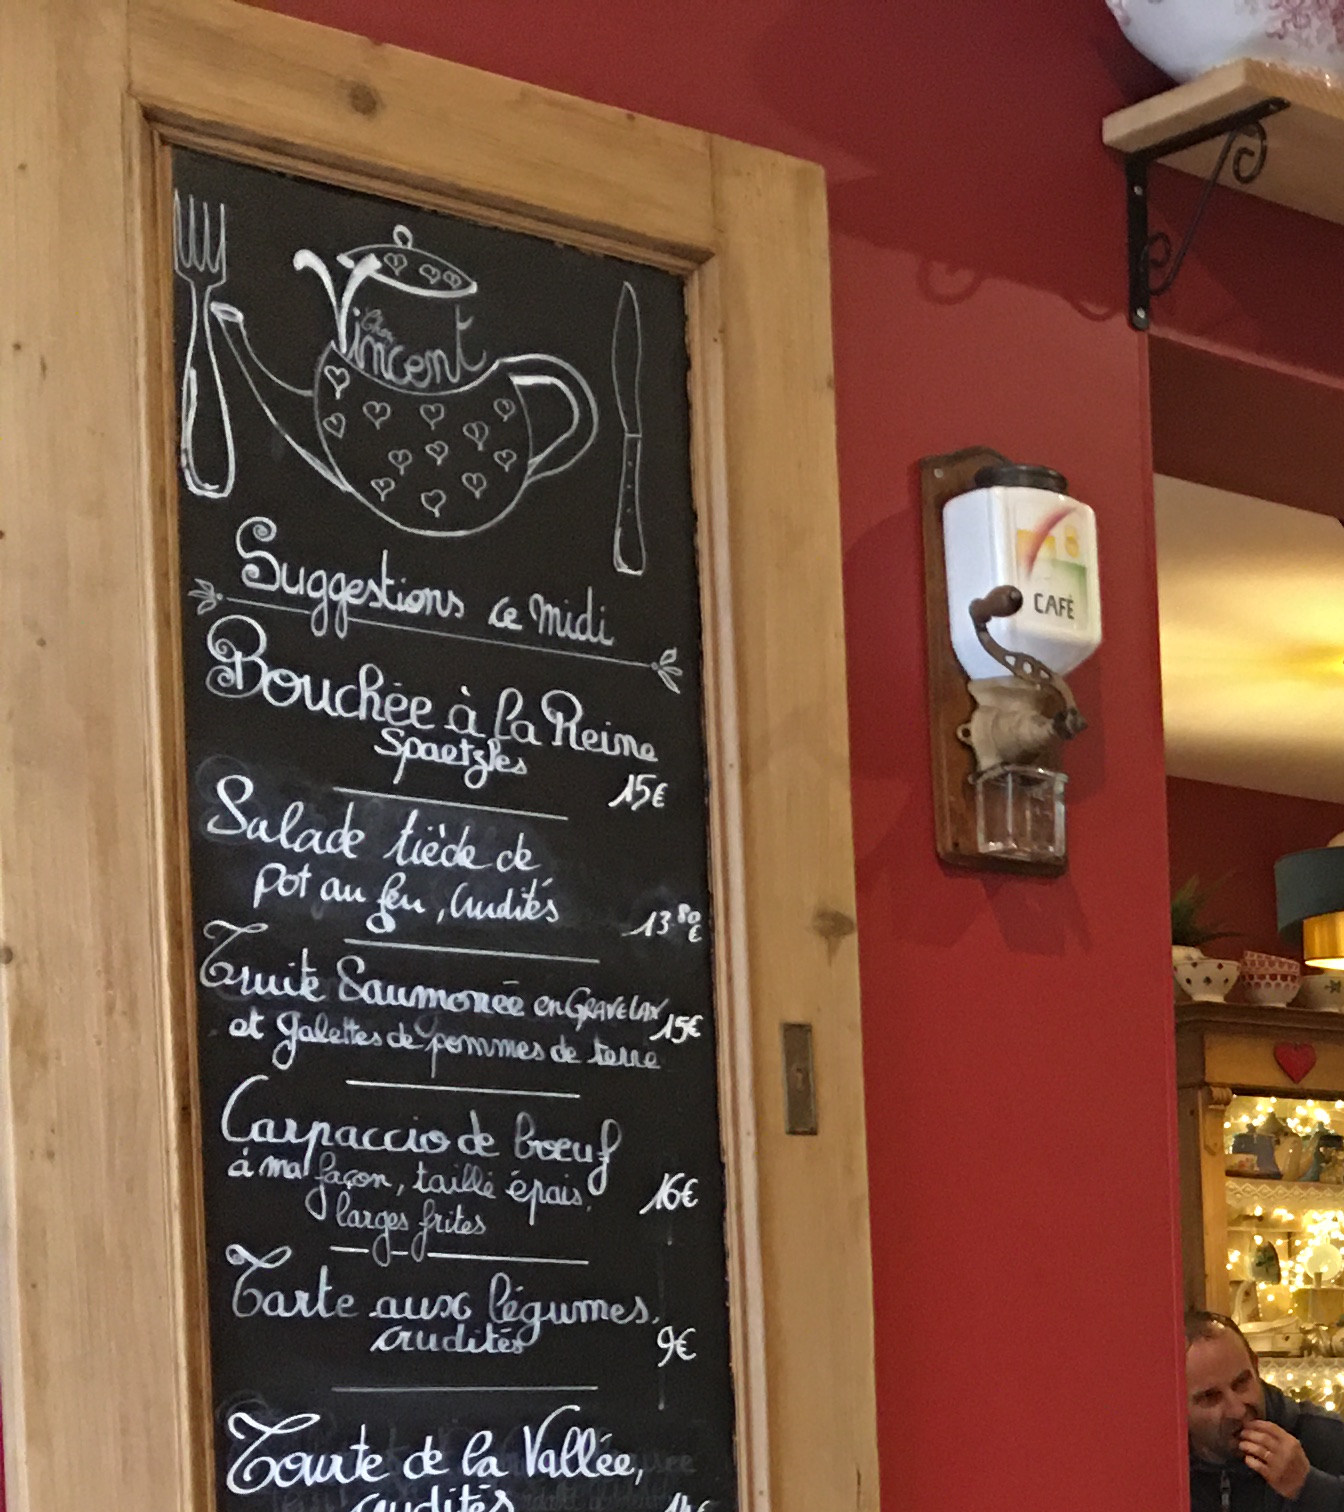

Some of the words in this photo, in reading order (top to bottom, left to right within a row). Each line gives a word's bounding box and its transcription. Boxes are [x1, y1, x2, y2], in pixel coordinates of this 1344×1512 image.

[293, 249, 487, 388] Vincent
[236, 517, 464, 638] Suggestions
[529, 586, 614, 646] midi
[206, 615, 434, 729] Bouchée
[444, 686, 485, 738] à
[493, 688, 543, 746] la
[542, 690, 659, 763] Reine
[374, 728, 528, 790] Spaetzles
[609, 775, 668, 811] 15€
[206, 775, 366, 858] Salade
[384, 808, 492, 870] tiède
[497, 831, 541, 871] de
[320, 878, 367, 902] au
[200, 920, 325, 1003] Truite
[228, 1006, 264, 1040] et
[386, 1023, 423, 1050] de
[424, 1032, 546, 1079] pommes
[550, 1034, 582, 1063] de
[586, 1034, 661, 1070] terre
[648, 1013, 704, 1045] 15€
[221, 1075, 452, 1180] Carpaccio
[457, 1109, 500, 1158] de
[259, 1155, 302, 1180] ma
[638, 1171, 700, 1215] 16€
[336, 1193, 409, 1267] larges
[408, 1199, 488, 1262] frites
[225, 1244, 360, 1319] Tarte
[369, 1292, 472, 1321] aux
[656, 1325, 697, 1368] 9€
[226, 1412, 385, 1495] Tourte
[402, 1435, 450, 1479] de
[462, 1430, 511, 1478] la
